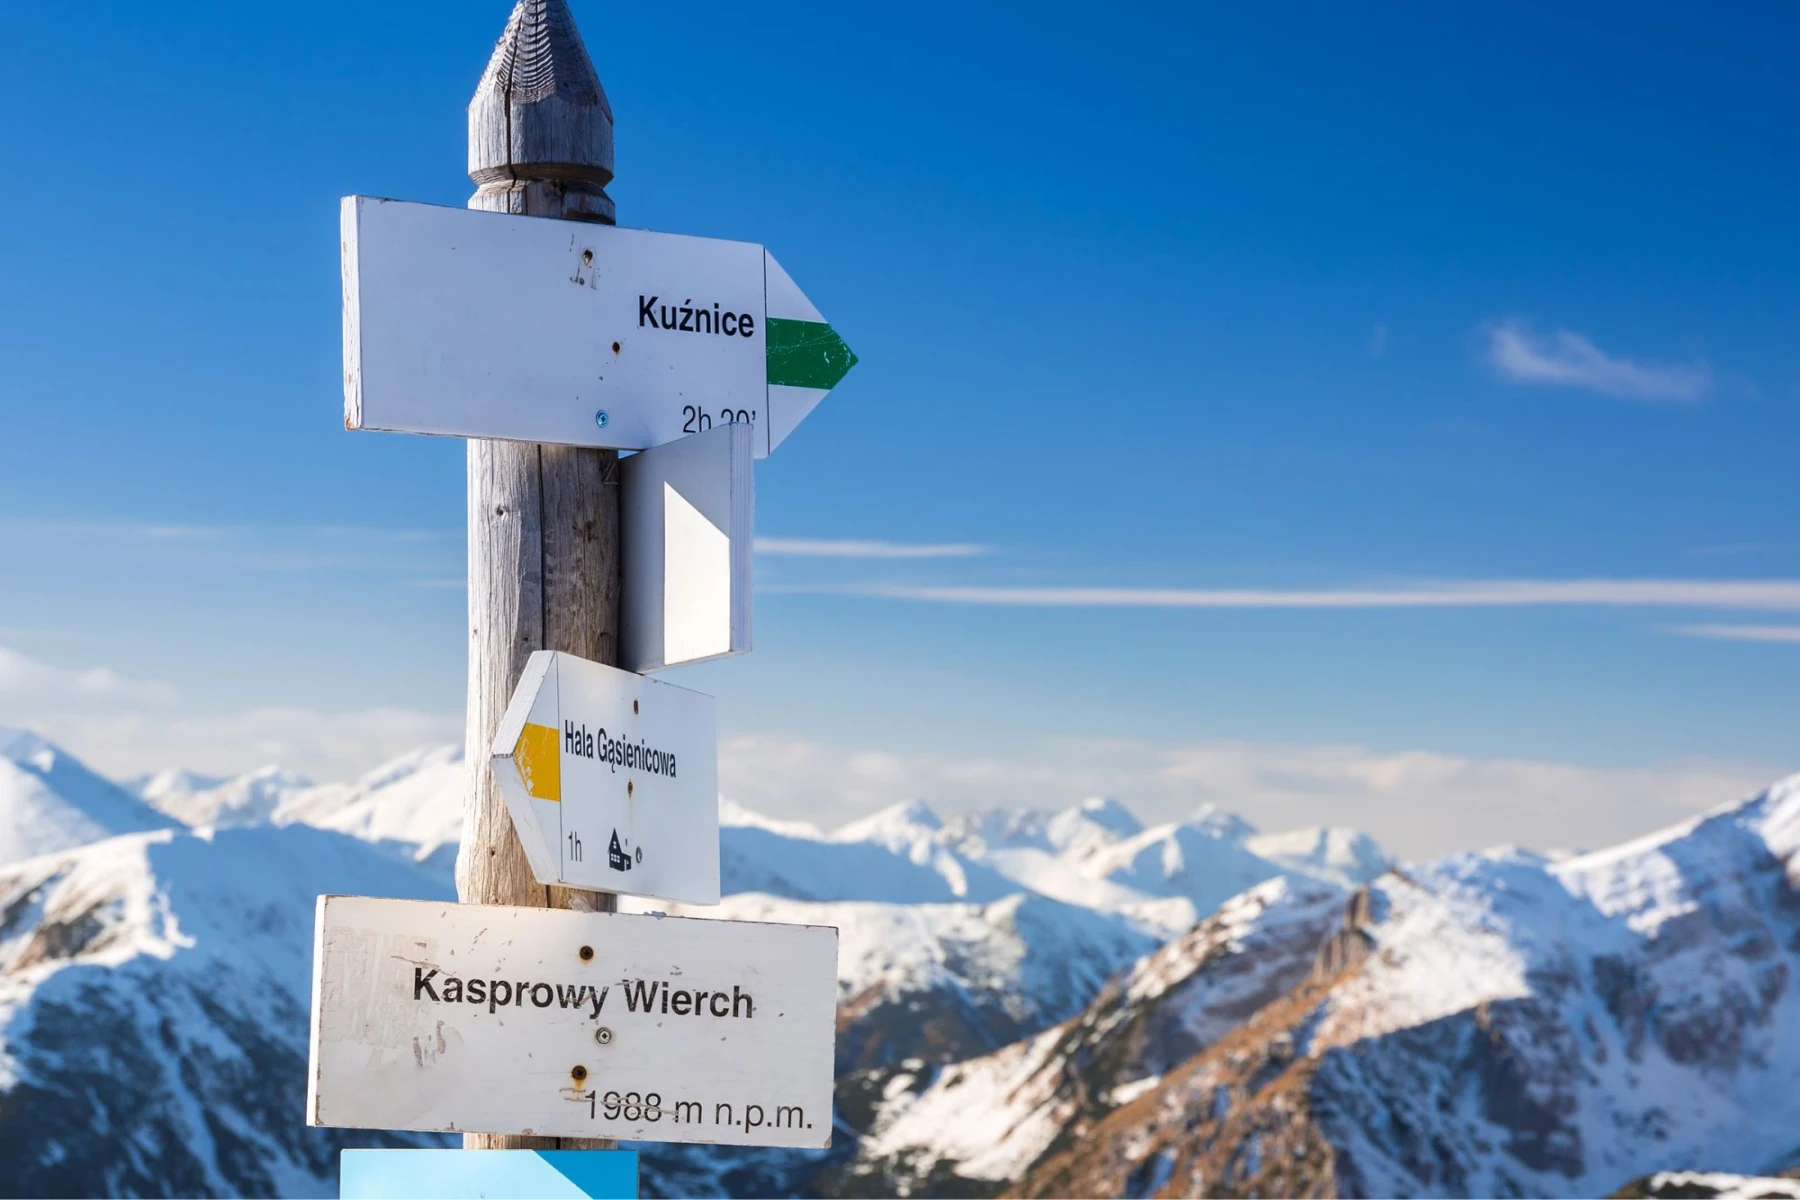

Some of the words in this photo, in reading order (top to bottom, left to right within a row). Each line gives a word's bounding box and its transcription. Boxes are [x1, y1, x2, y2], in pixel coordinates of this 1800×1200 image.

[638, 294, 755, 338] Kuźnice
[682, 405, 712, 433] 2h
[564, 719, 594, 760] Hala
[597, 727, 677, 778] Gąsienicowa
[568, 830, 583, 862] 1h
[413, 967, 609, 1019] Kasprowy
[622, 979, 753, 1018] Wierch
[585, 1089, 662, 1122] 1988
[674, 1100, 702, 1124] m
[715, 1102, 813, 1133] n.p.m.
